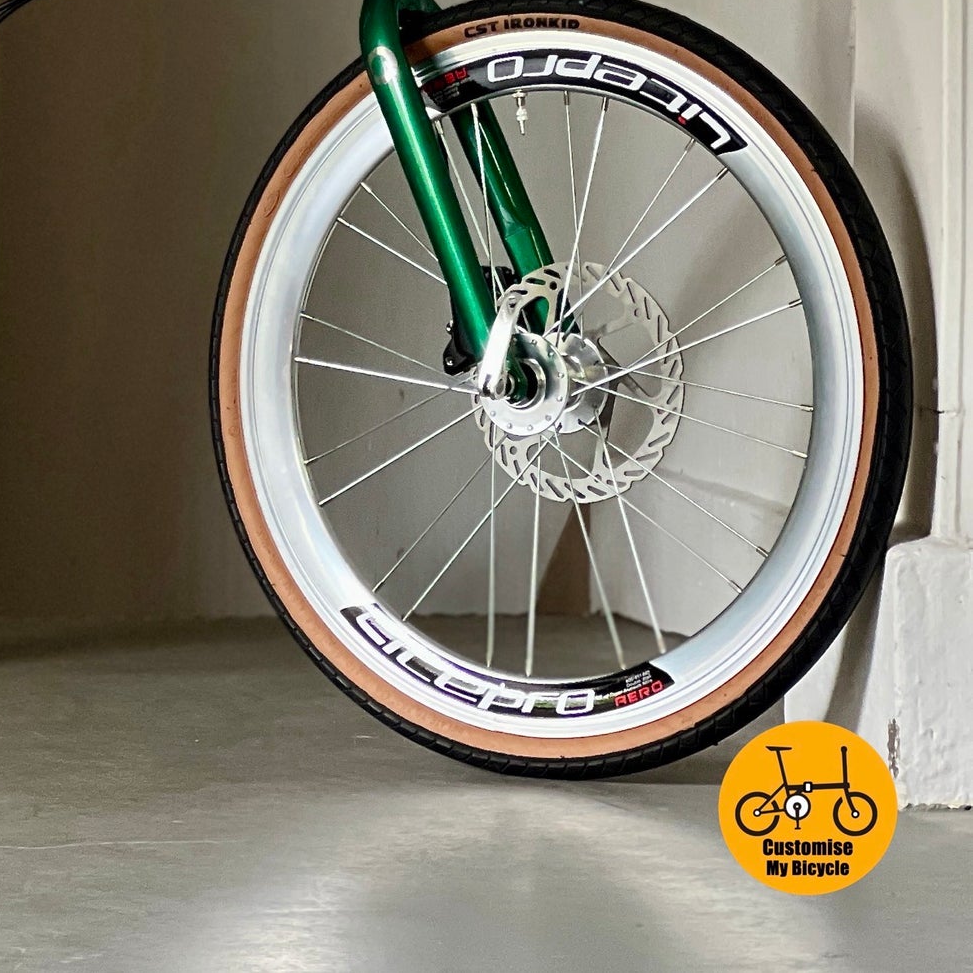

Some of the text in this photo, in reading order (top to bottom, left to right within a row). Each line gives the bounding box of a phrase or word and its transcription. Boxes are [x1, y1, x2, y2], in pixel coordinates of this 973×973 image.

[464, 17, 580, 38] CST IRONKID
[614, 680, 664, 707] AERO
